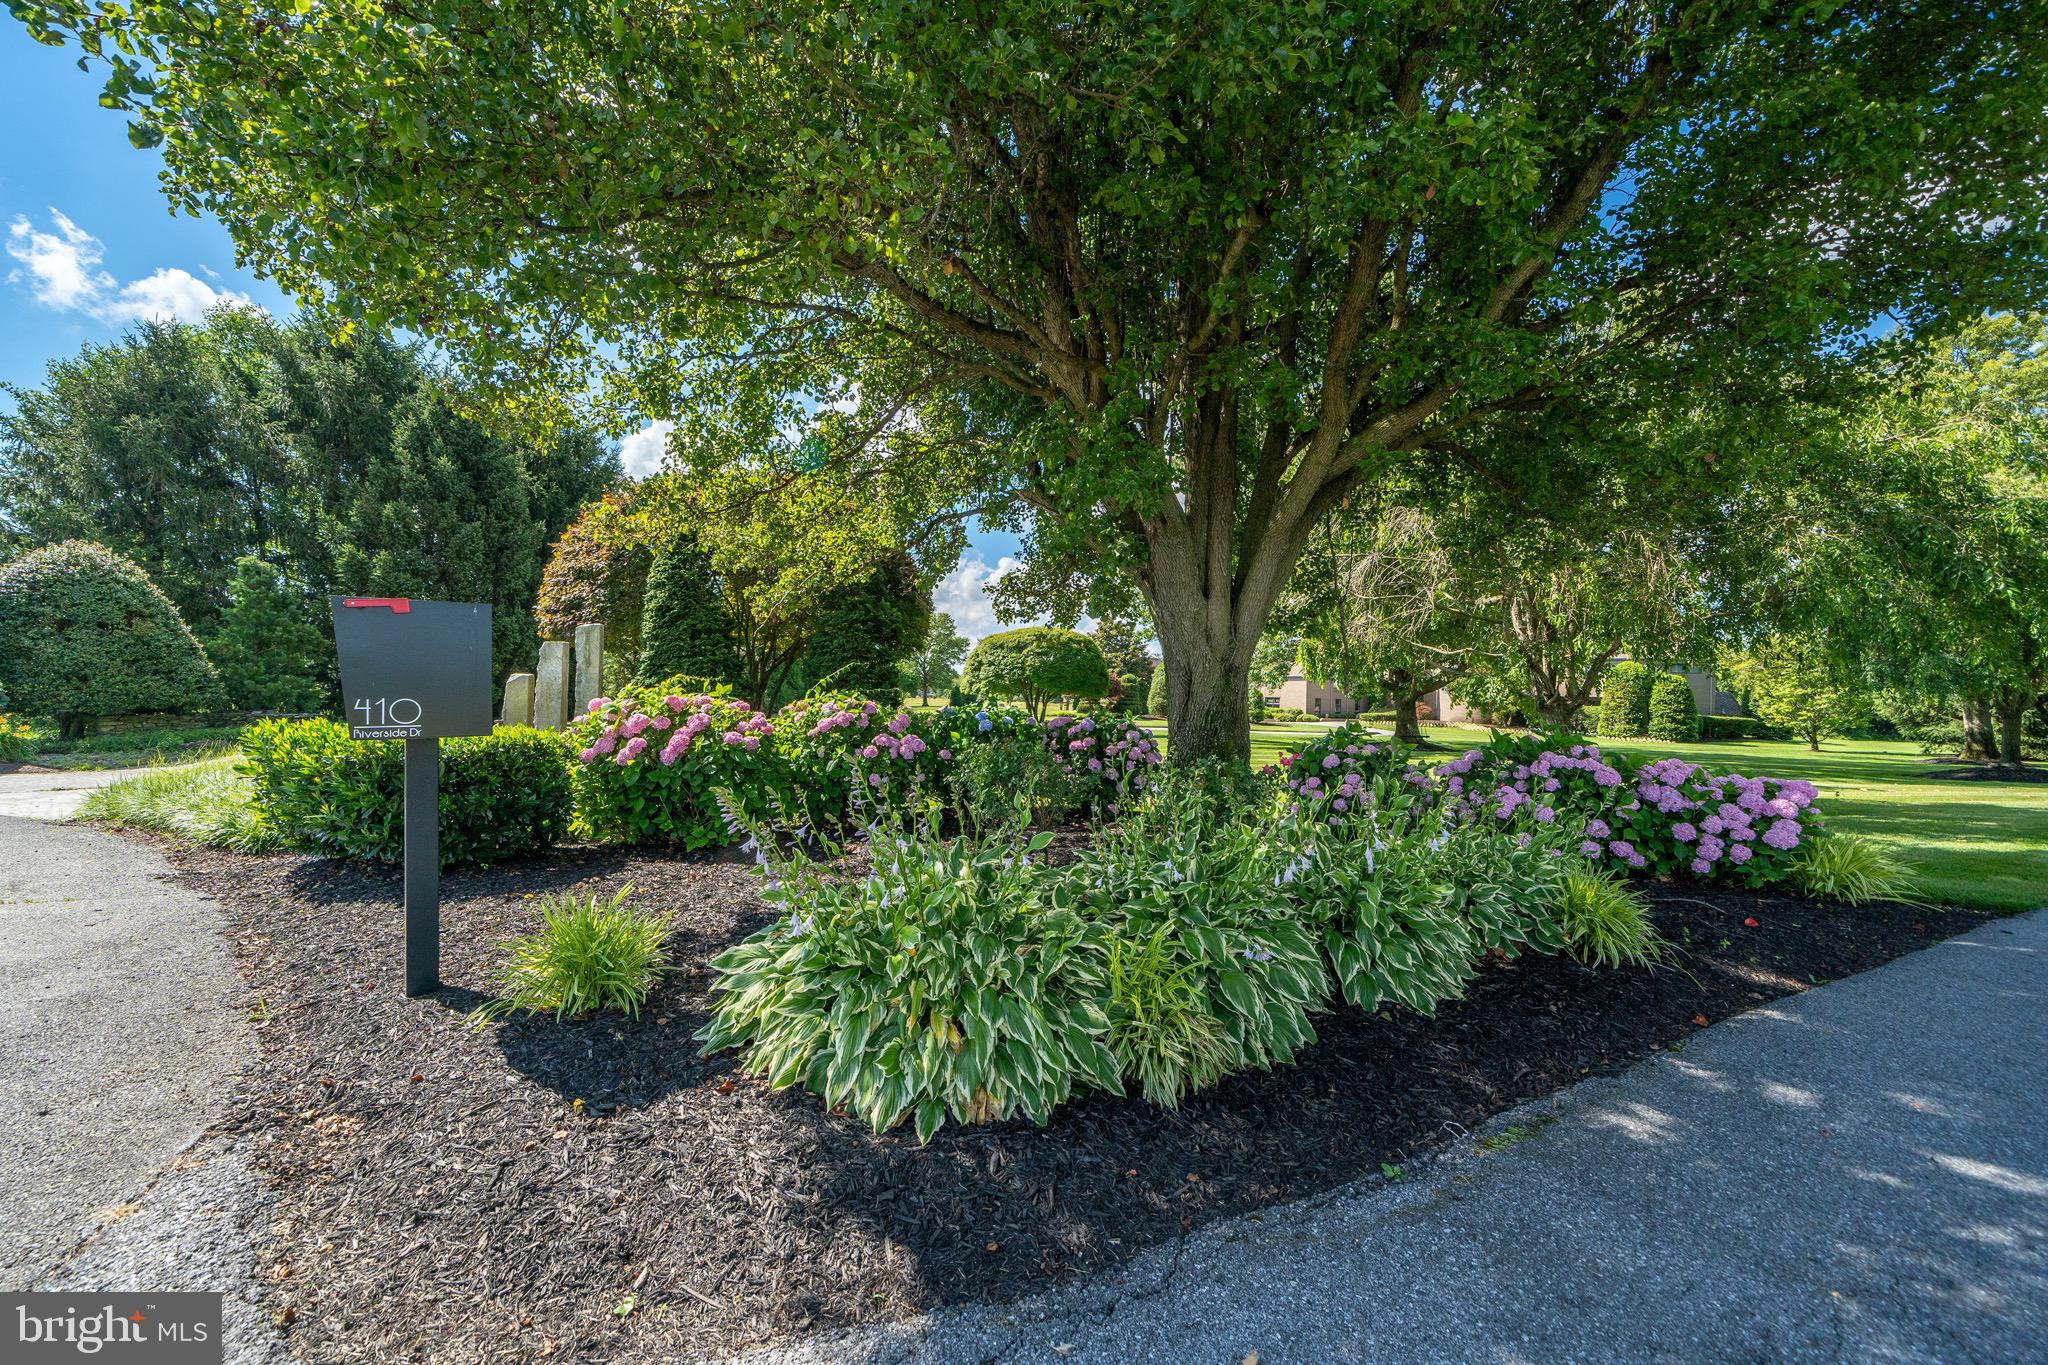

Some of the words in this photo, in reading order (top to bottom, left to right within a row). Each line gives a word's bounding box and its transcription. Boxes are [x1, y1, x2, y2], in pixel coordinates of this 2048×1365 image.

[353, 698, 422, 725] 410
[353, 729, 408, 739] Riverside
[409, 728, 422, 737] Dr
